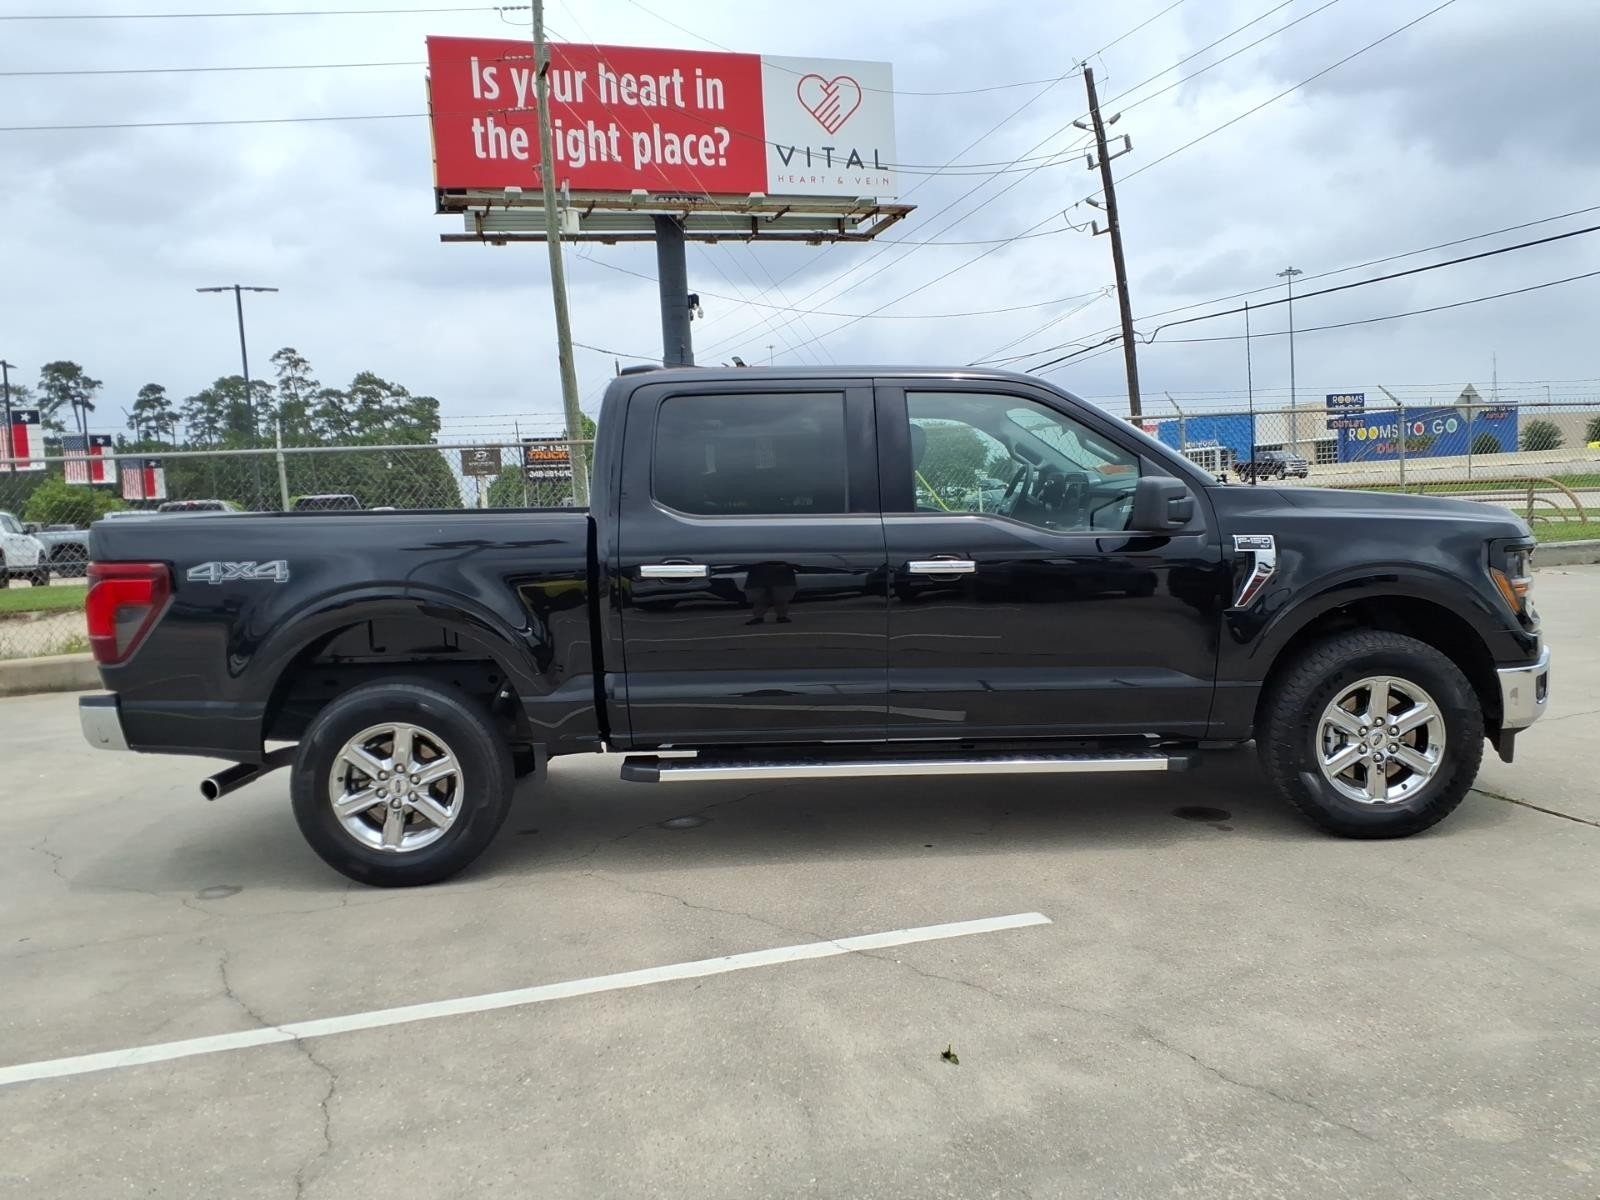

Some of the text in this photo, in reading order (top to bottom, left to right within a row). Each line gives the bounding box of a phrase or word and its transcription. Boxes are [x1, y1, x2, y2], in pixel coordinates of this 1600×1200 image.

[470, 56, 500, 99] Is
[598, 62, 685, 109] heart
[695, 68, 725, 110] in
[472, 116, 731, 170] the ight place?
[776, 145, 888, 170] VITAL
[777, 175, 890, 186] HEART & VEIN
[1332, 395, 1363, 404] ROOMS
[1332, 420, 1364, 429] OUTLET
[1348, 418, 1458, 441] ROOMS TO GO
